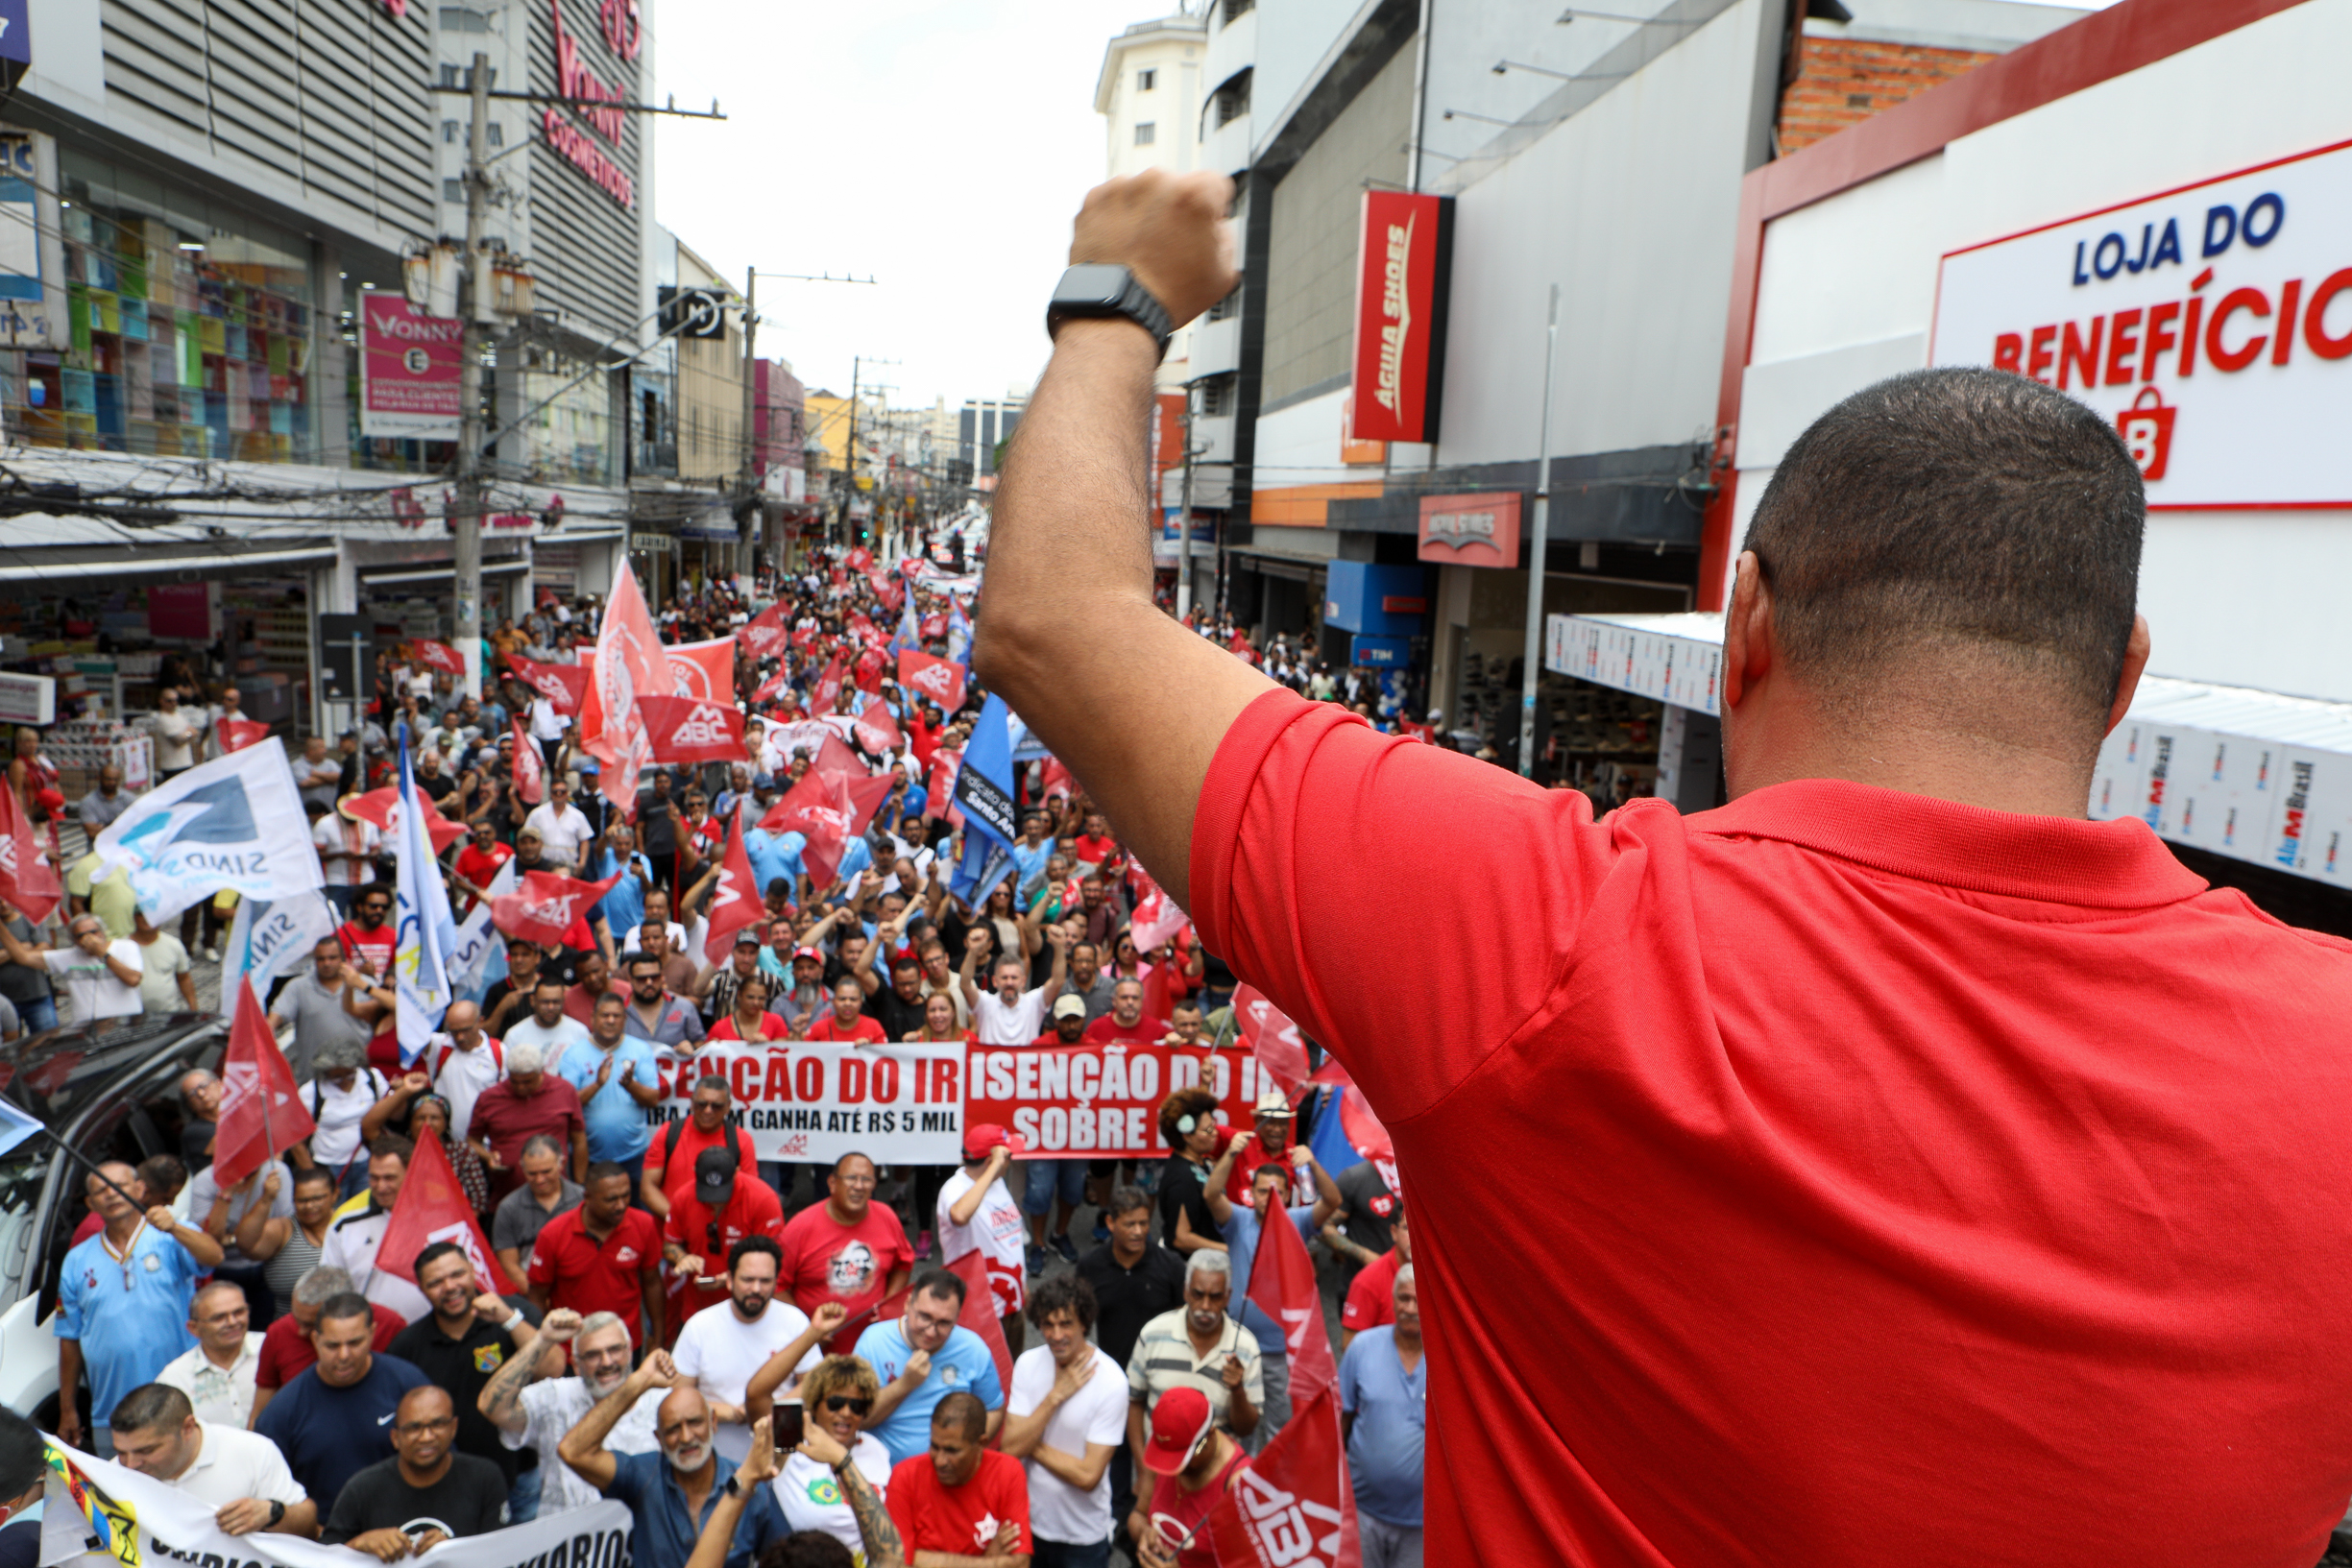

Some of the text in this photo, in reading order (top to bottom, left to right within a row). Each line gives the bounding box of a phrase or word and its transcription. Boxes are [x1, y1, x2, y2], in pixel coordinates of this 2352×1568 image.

[2072, 191, 2286, 287] LOJA DO
[369, 307, 463, 341] VONNY
[1374, 224, 1406, 410] ÁGUIA SHOES
[1992, 265, 2352, 391] BENEFÍCIO
[2124, 418, 2159, 472] B
[671, 720, 733, 743] ABC
[965, 789, 999, 823] Santo
[2275, 760, 2316, 868] AluMBrasil
[656, 1047, 958, 1110] SENÇÃO DO IR
[970, 1044, 1160, 1109] ISENÇÃO
[1170, 1053, 1231, 1103] DO
[751, 1108, 823, 1131] GANHA
[828, 1107, 861, 1133] ATÉ
[868, 1109, 895, 1134] R$
[903, 1113, 915, 1132] 5
[921, 1112, 958, 1132] MIL
[1012, 1106, 1147, 1151] SOBRE
